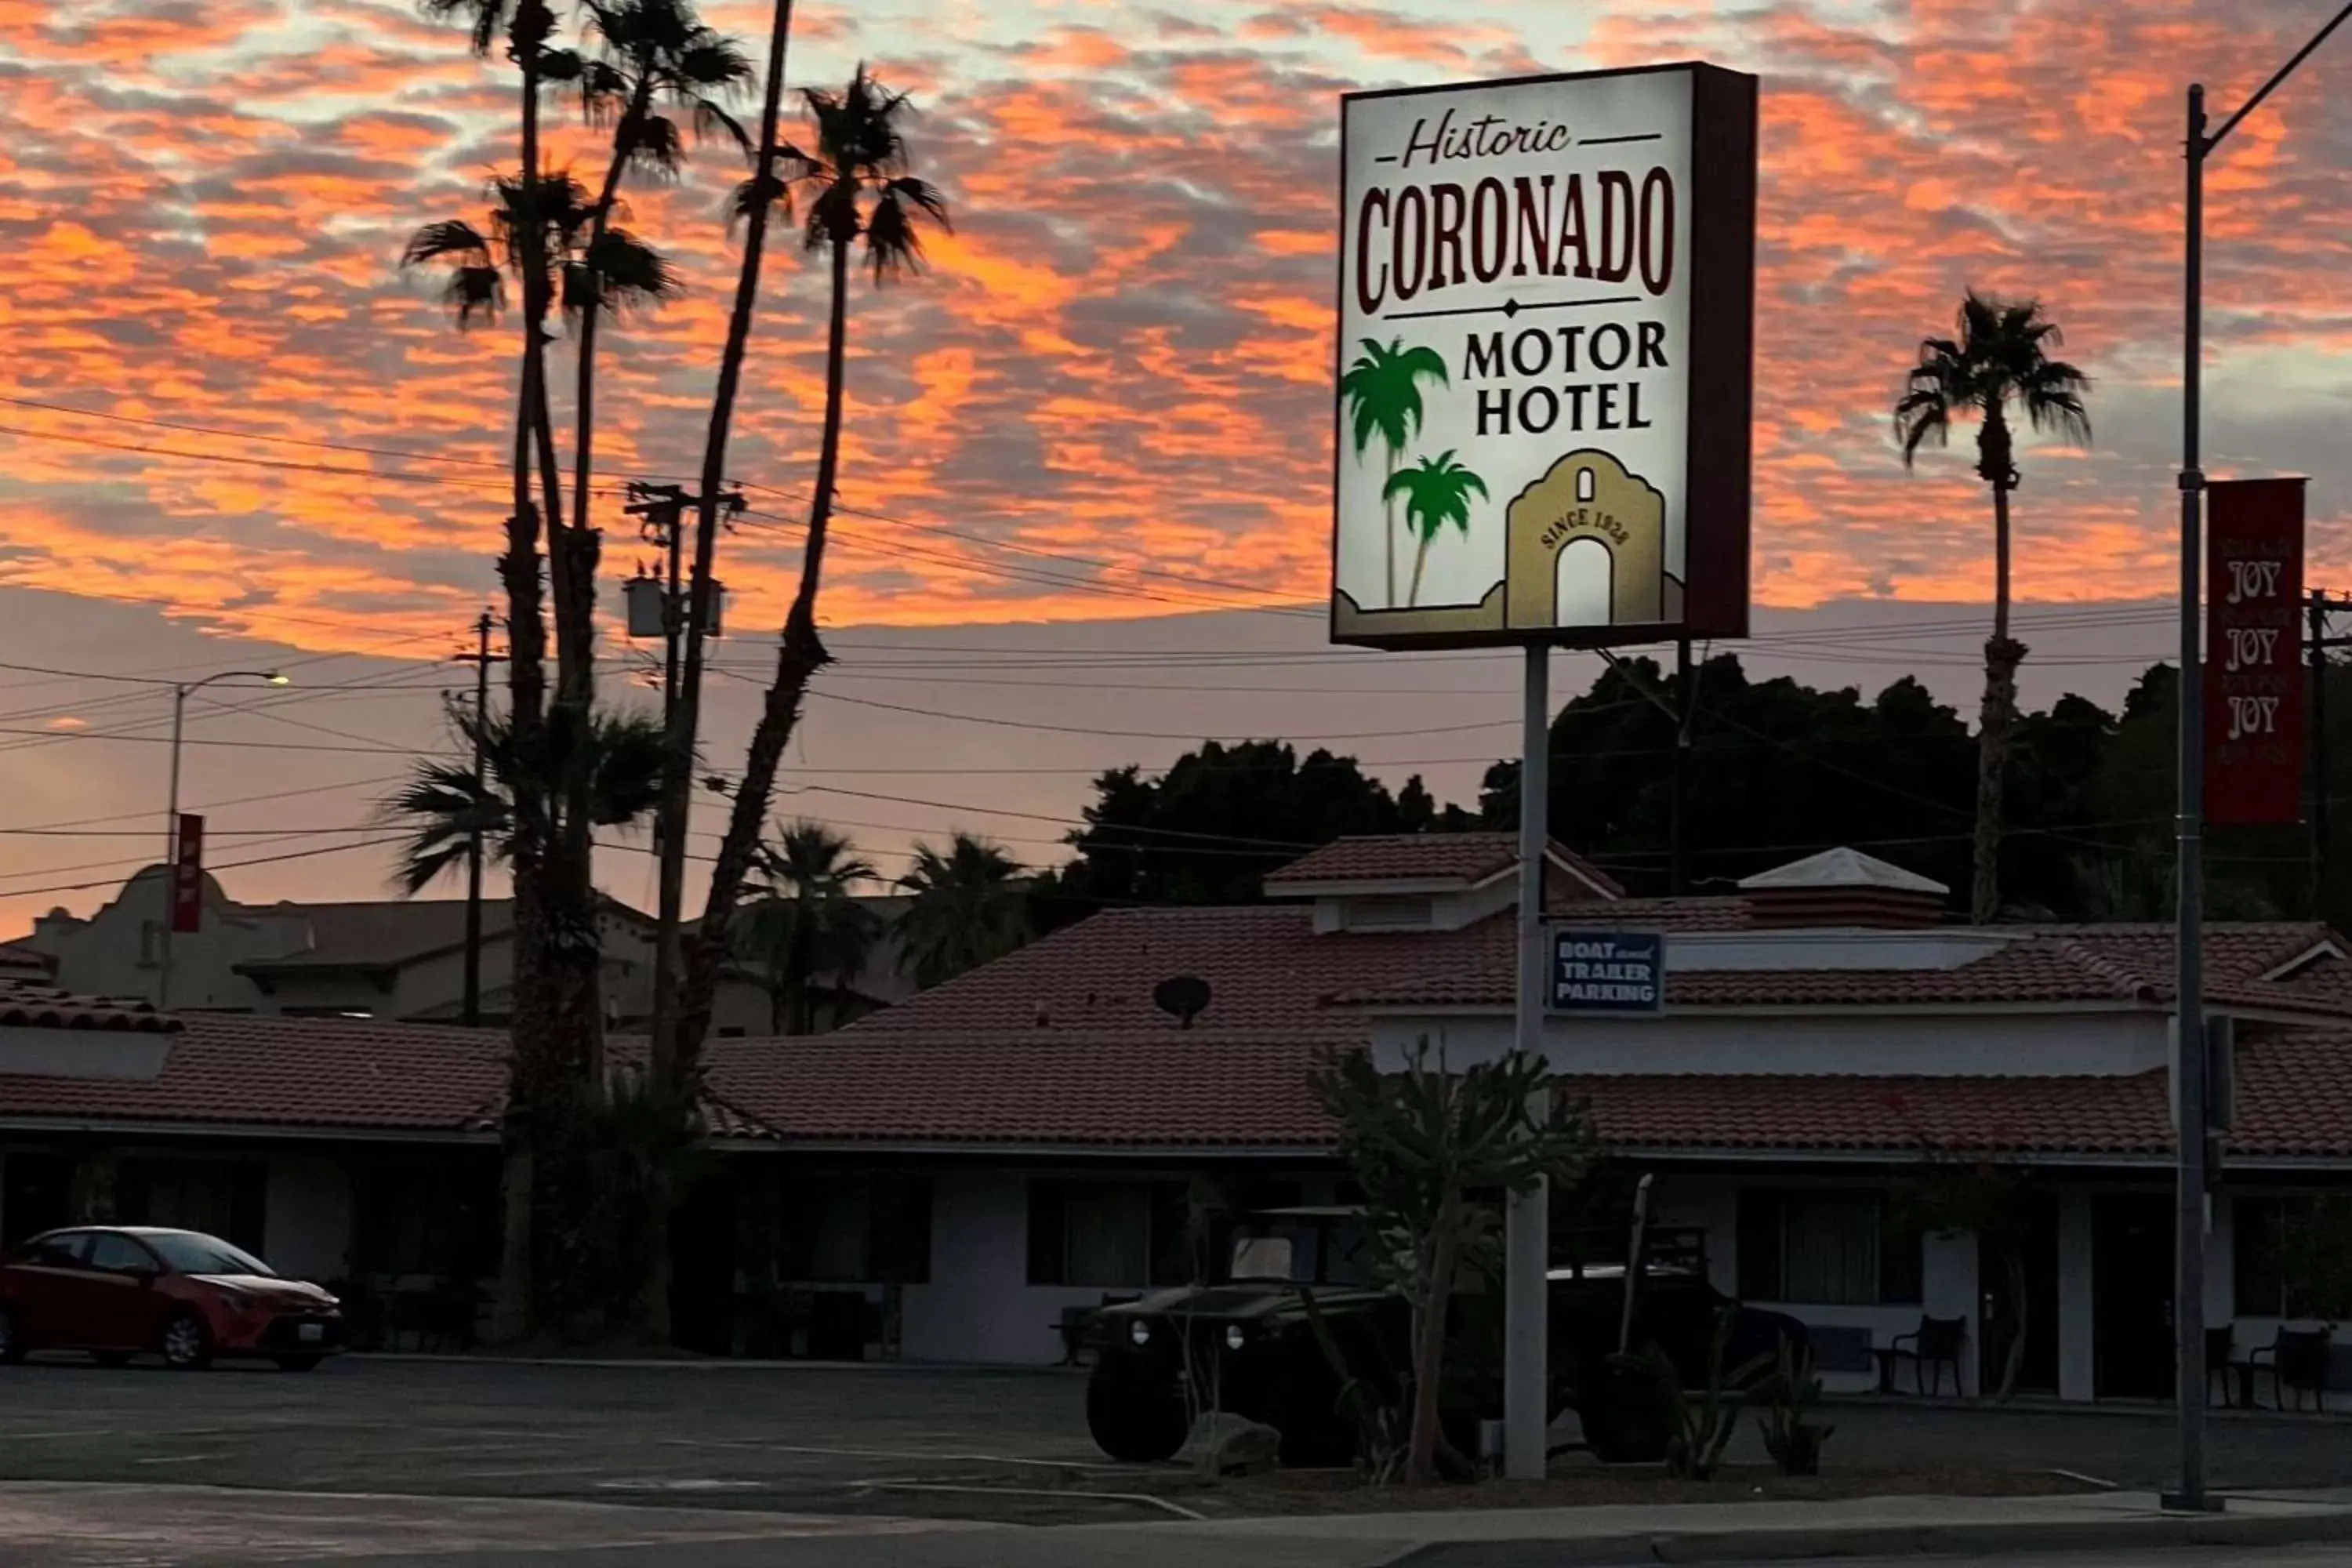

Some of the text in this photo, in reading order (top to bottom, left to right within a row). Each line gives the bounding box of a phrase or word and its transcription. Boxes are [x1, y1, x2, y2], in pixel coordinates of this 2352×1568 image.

[1403, 108, 1570, 168] Historic
[1357, 166, 1675, 314] CORONADO
[1463, 321, 1668, 379] MOTOR
[1475, 382, 1652, 435] HOTEL
[1541, 508, 1588, 550] SINCE
[2227, 561, 2281, 604] JOY
[2225, 629, 2279, 672] JOY
[2227, 696, 2280, 740] JOY
[1559, 942, 1616, 959] BOAT
[1556, 982, 1655, 1002] PARKING
[1562, 963, 1652, 982] TRAILER
